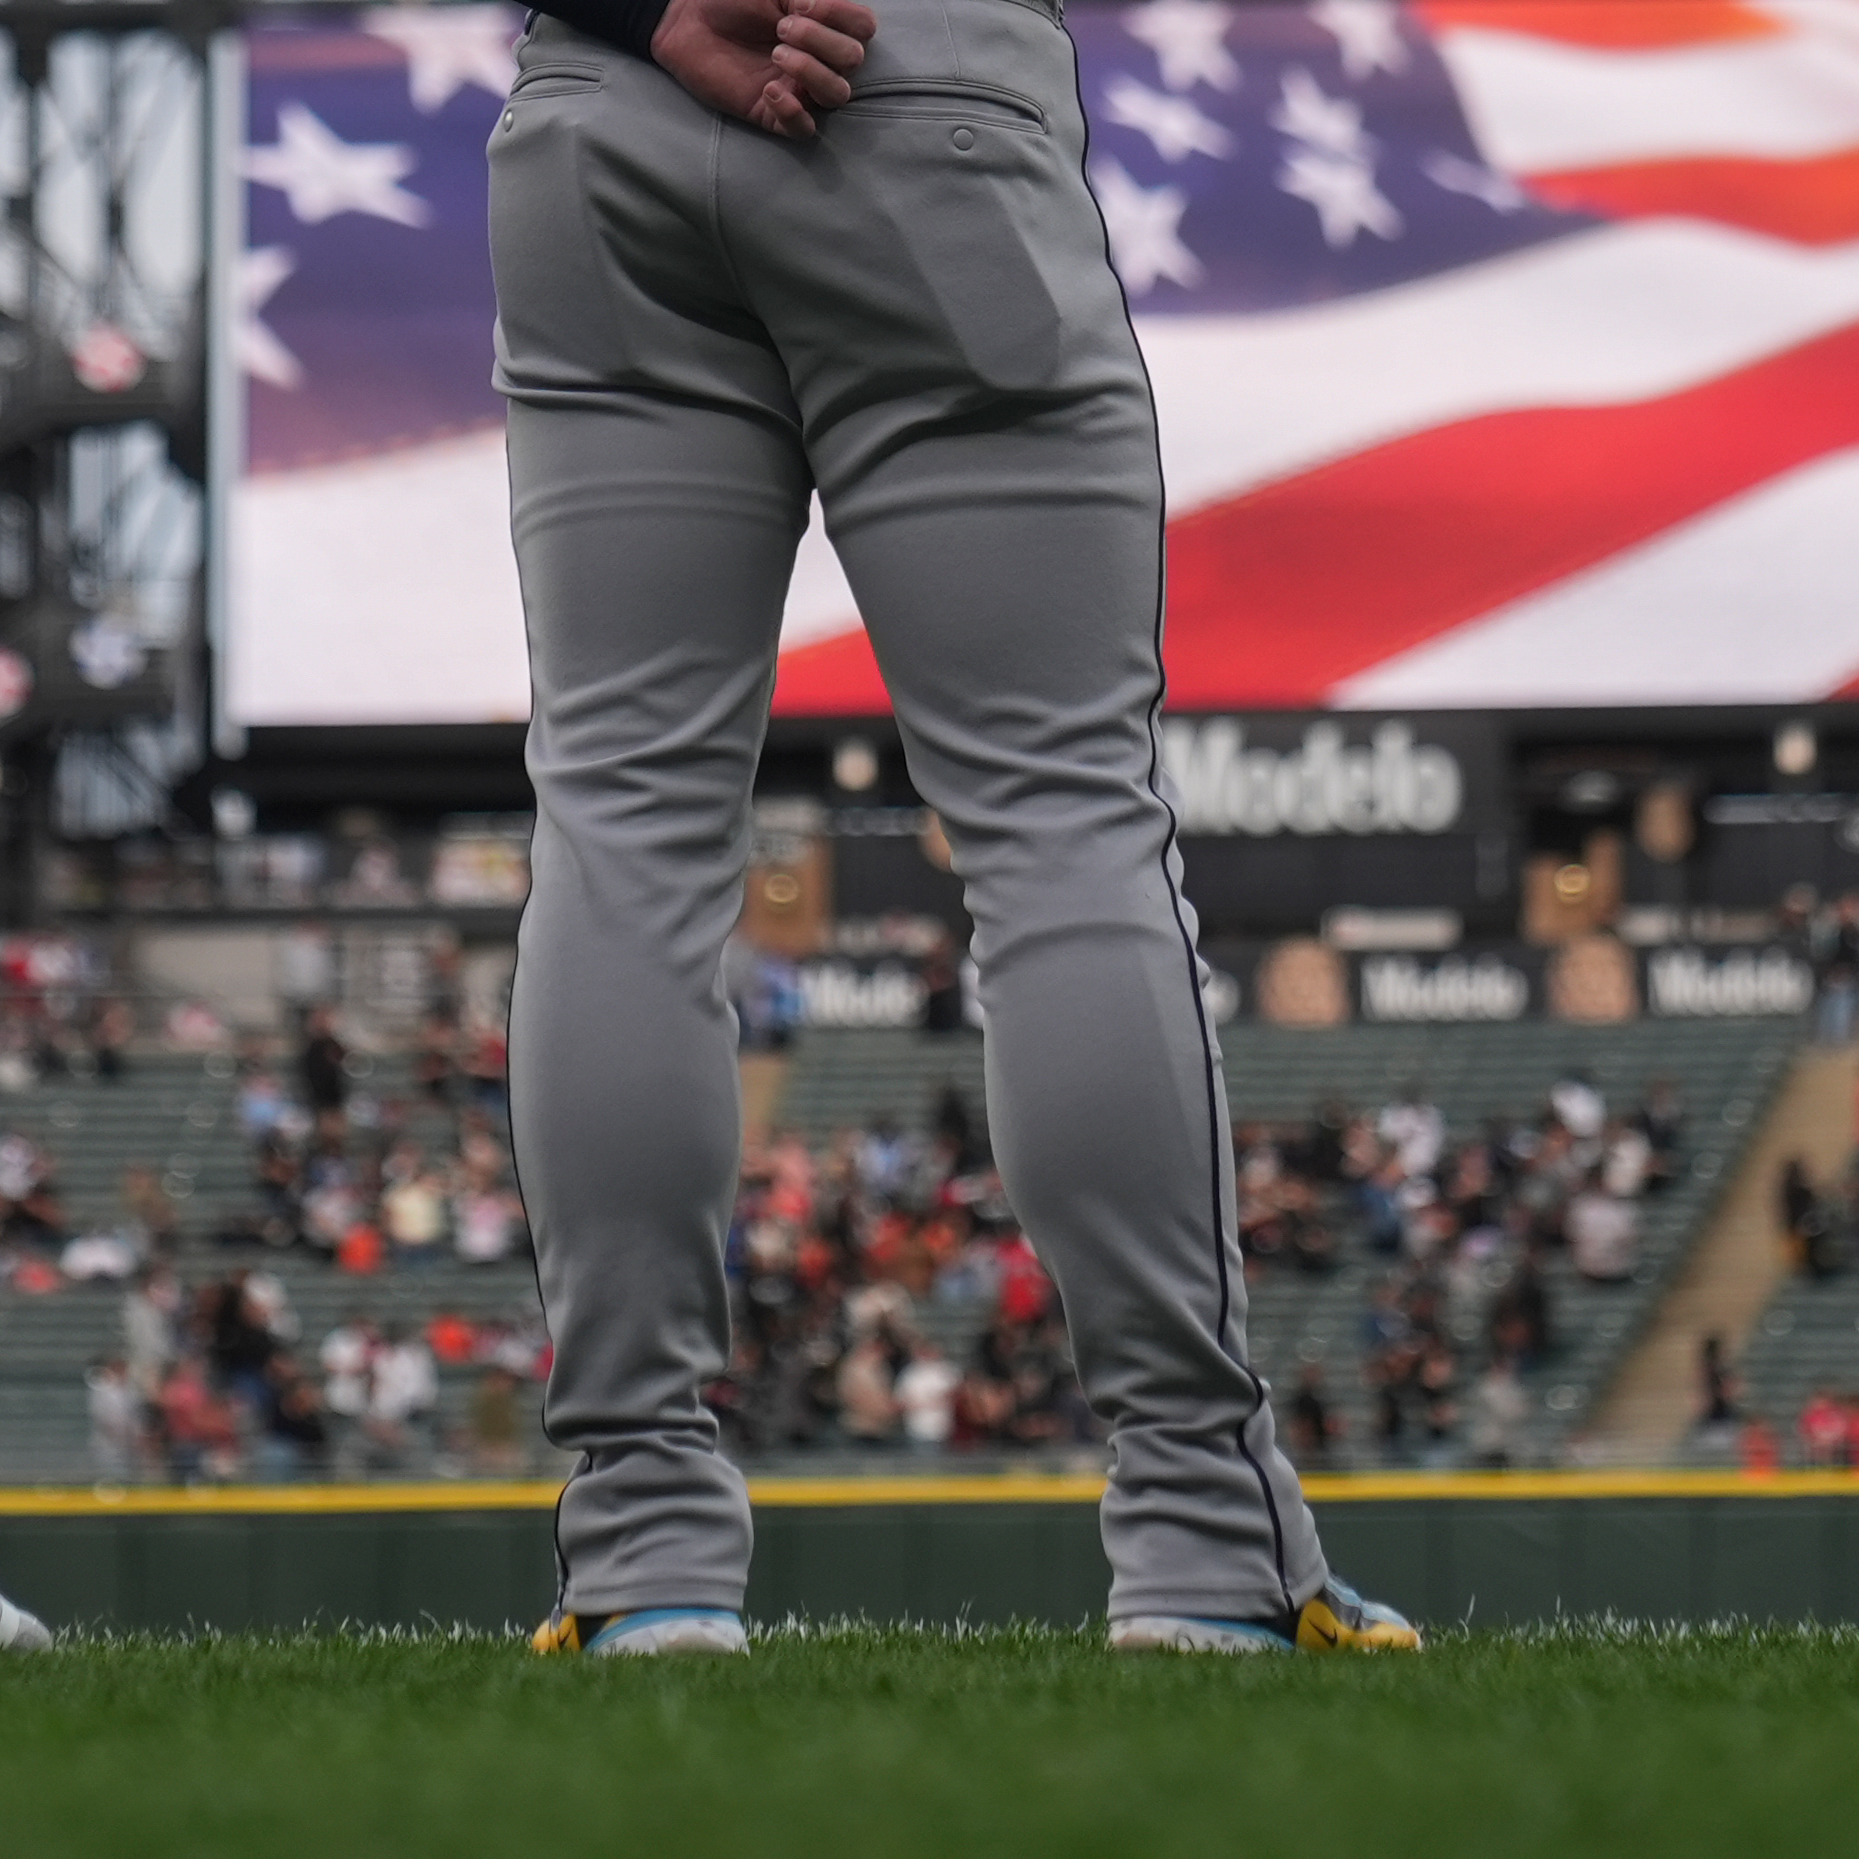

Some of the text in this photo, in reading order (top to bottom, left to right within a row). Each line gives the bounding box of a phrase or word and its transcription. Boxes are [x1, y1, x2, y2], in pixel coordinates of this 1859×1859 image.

[1152, 720, 1464, 838] Modelo
[1360, 953, 1530, 1023] Modelo
[1648, 947, 1815, 1022] Modelo
